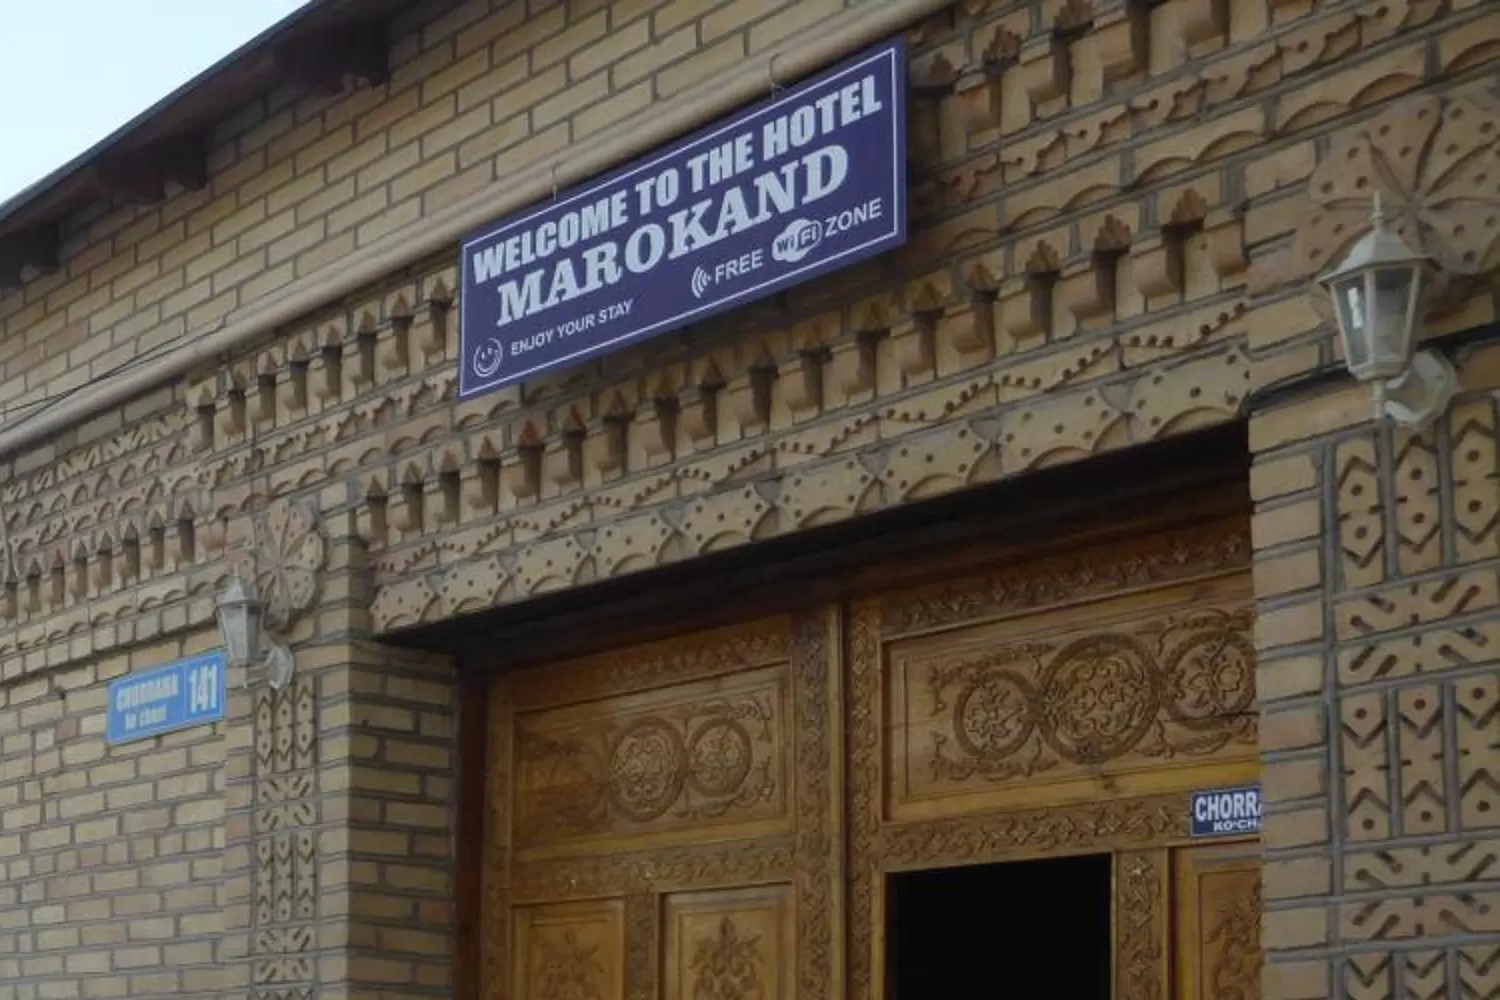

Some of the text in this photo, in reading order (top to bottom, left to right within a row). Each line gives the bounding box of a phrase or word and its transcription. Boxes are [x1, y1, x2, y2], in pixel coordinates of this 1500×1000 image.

[473, 75, 882, 284] WELCOME TO THE HOTEL
[496, 144, 849, 327] MAROKAND
[713, 249, 764, 285] FREE
[825, 198, 883, 238] ZONE
[510, 299, 634, 357] ENJOY YOUR STAY
[188, 663, 218, 714] 141
[1213, 818, 1260, 832] KO'CH
